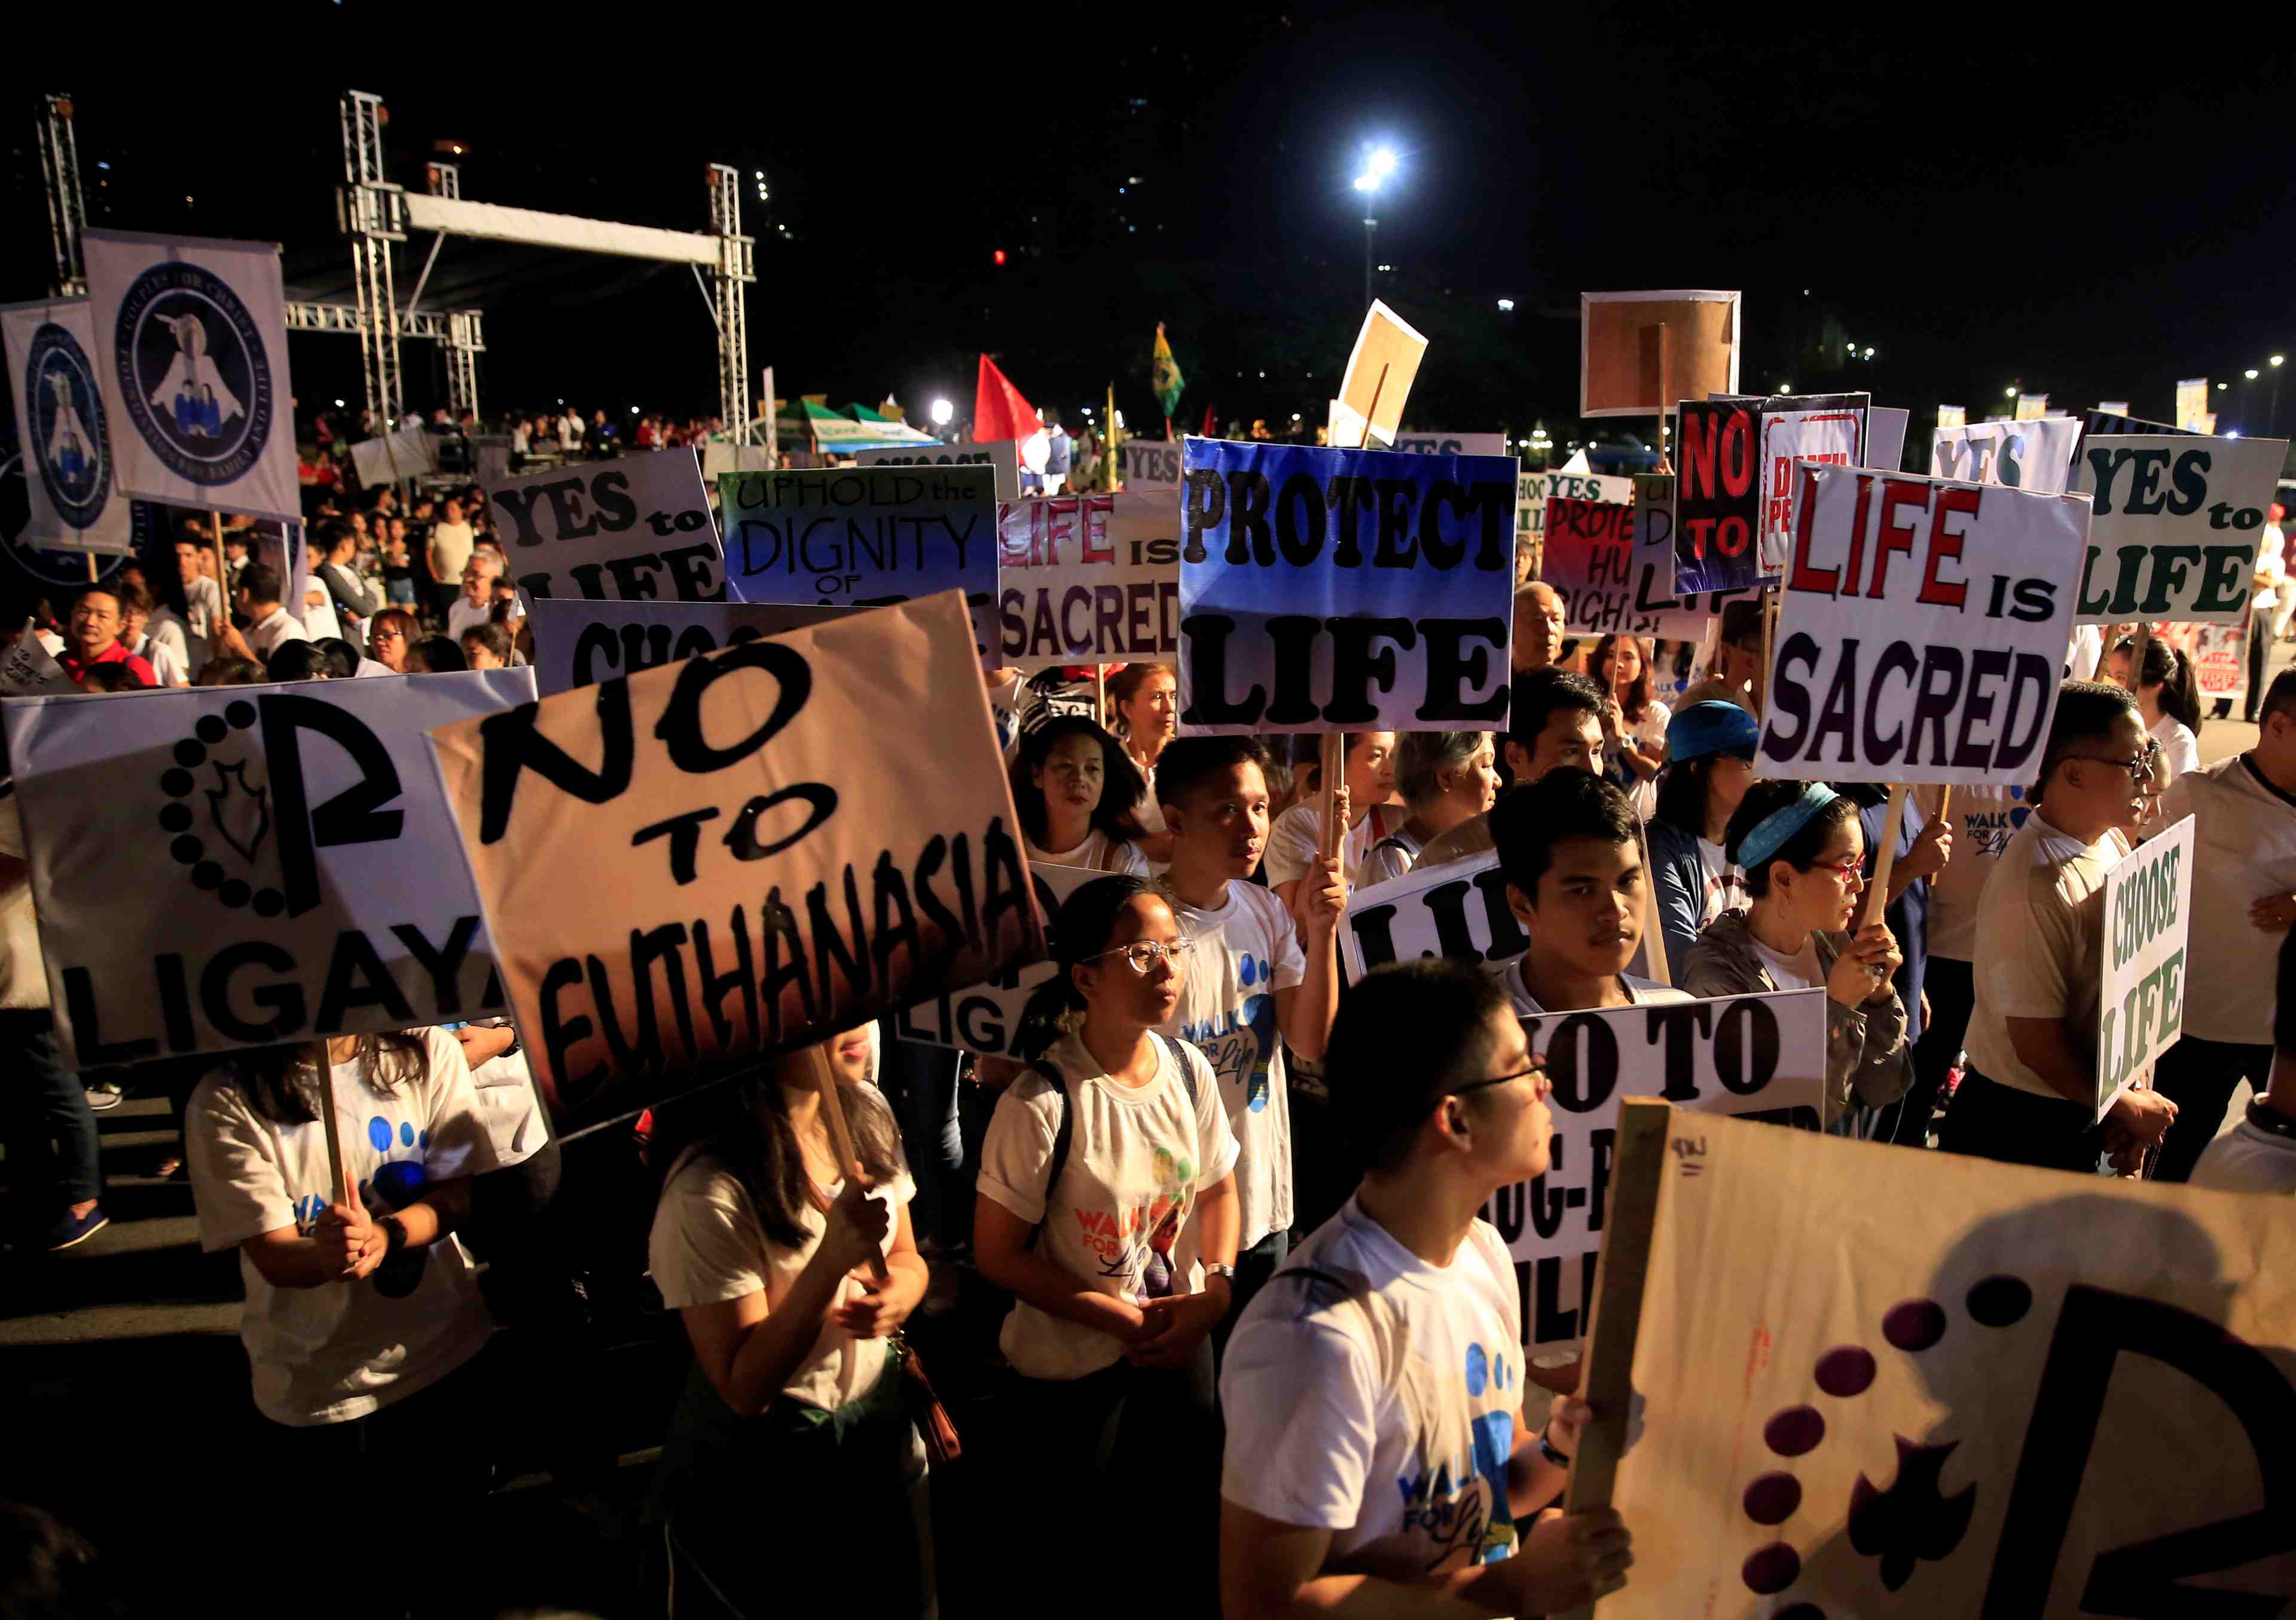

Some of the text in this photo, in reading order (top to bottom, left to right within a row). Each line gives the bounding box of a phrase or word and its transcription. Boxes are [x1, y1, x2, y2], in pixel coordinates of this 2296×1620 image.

[1128, 446, 1177, 484] YES
[1547, 474, 1601, 502] YES
[1682, 408, 1756, 500] NO
[2087, 447, 2264, 530] YES to
[492, 471, 707, 548] YES to
[737, 474, 977, 510] UPHOLD the
[1183, 468, 1518, 570] PROTECT
[739, 514, 978, 576] DIGNITY
[1130, 539, 1180, 565] IS
[1686, 515, 1750, 560] TO
[1788, 466, 1984, 613] LIFE
[1985, 574, 2058, 622] IS
[815, 575, 862, 594] OF
[2076, 544, 2253, 616] LIFE
[1180, 615, 1510, 725] LIFE
[1761, 632, 2051, 774] SACRED
[478, 641, 812, 845] NO
[630, 781, 839, 887] TO
[1964, 812, 2010, 829] WALK
[1967, 829, 1990, 840] FOR
[2113, 843, 2181, 972] CHOOSE
[538, 817, 1046, 1108] EUTHANASIA
[898, 995, 1033, 1058] LIG
[1181, 1008, 1244, 1043] WALK
[1522, 997, 1779, 1114] O TO
[2099, 949, 2182, 1106] LIFE
[1073, 1205, 1146, 1239] WALK
[1083, 1233, 1120, 1258] FOR
